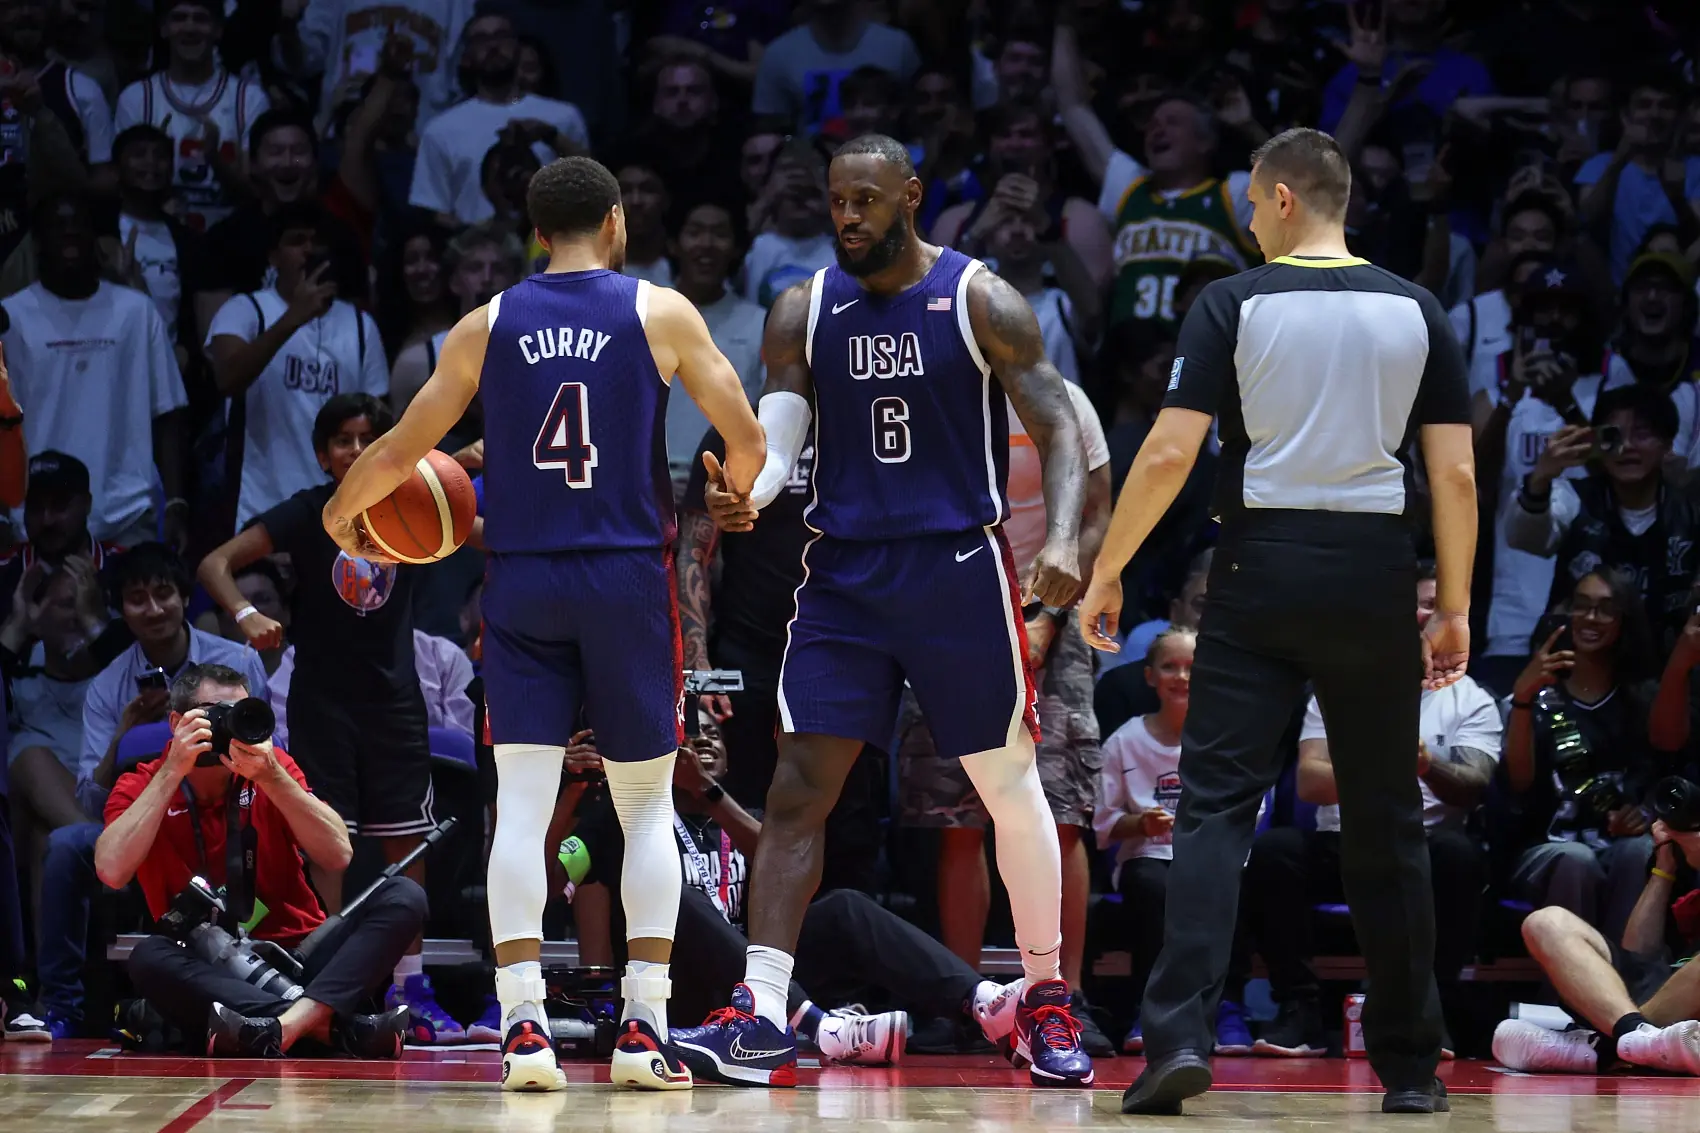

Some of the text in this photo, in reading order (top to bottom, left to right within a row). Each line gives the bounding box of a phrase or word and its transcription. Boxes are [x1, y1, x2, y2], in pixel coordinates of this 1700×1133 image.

[518, 327, 612, 365] CURRY
[849, 332, 924, 380] USA
[284, 353, 339, 397] USA
[532, 382, 599, 489] 4
[871, 396, 912, 463] 6
[676, 823, 717, 898] USA BASKETBALL
